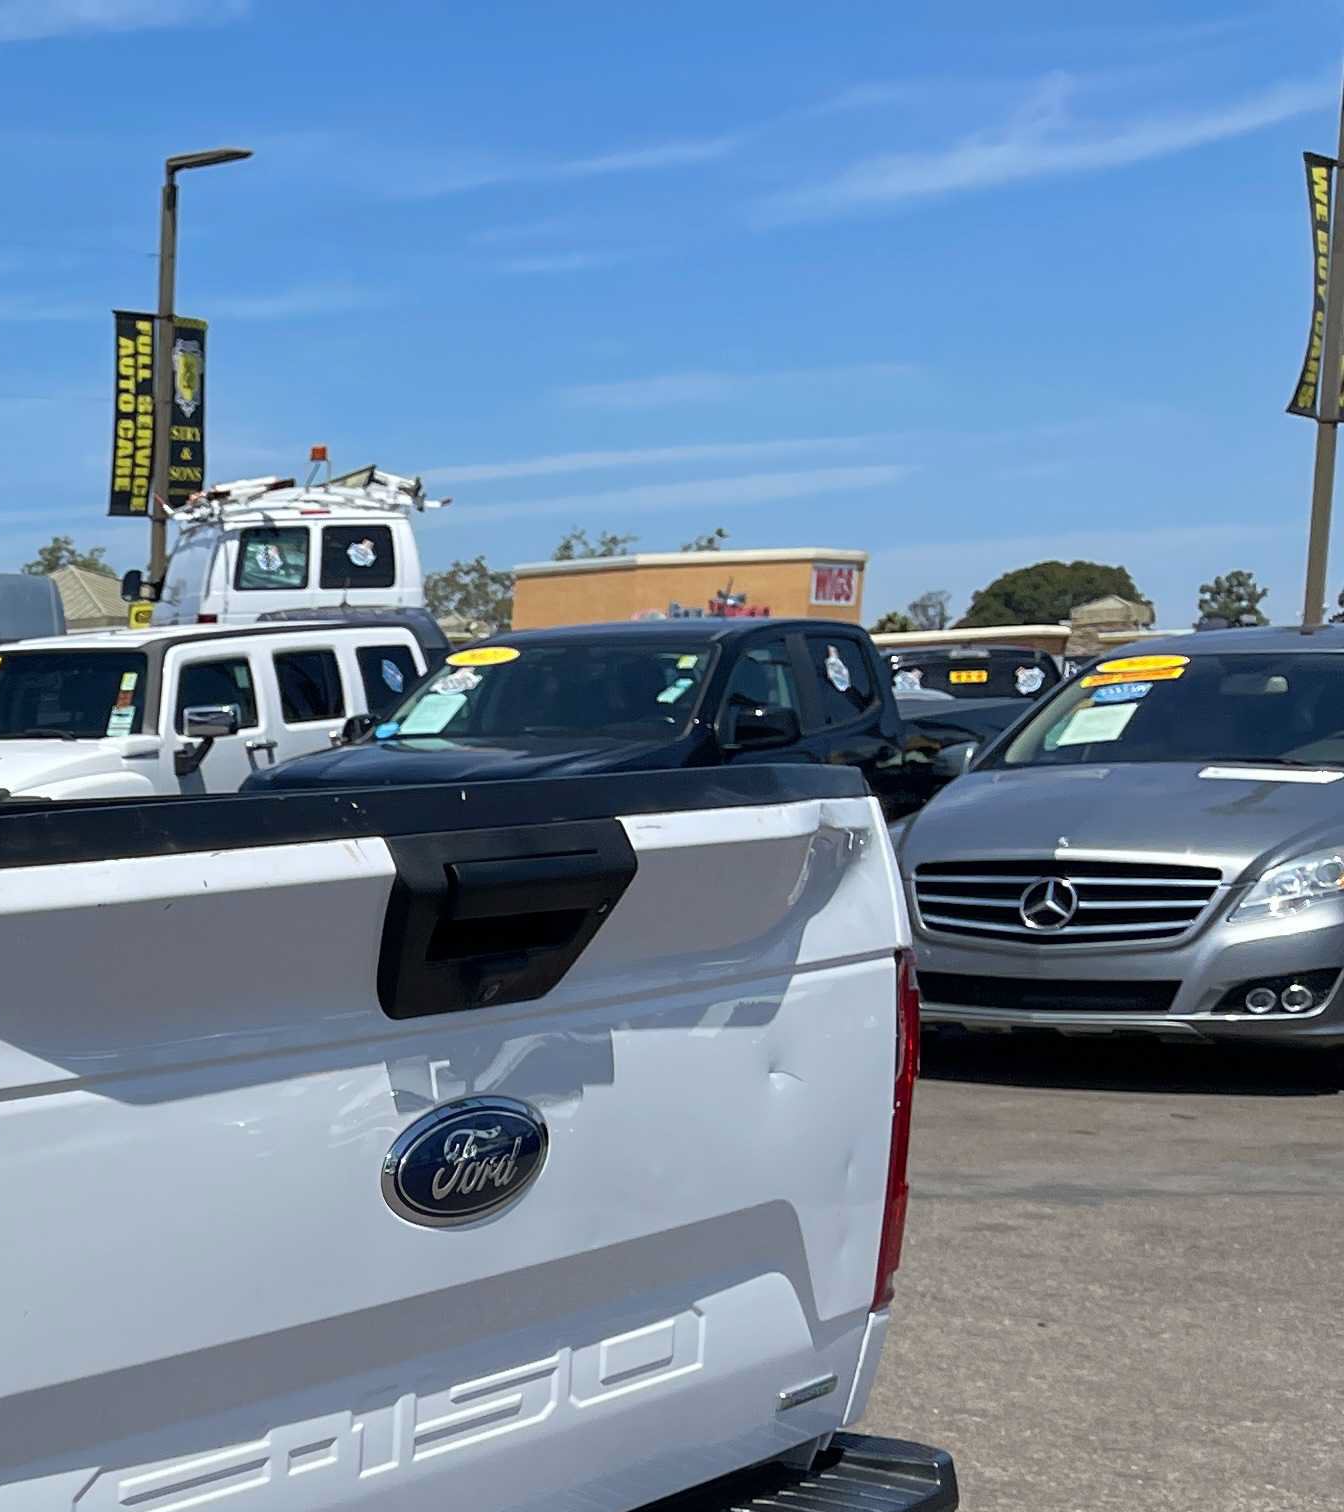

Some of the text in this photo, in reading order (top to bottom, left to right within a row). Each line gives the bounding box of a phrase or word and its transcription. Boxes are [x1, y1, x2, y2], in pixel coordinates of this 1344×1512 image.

[1311, 166, 1329, 222] WE
[113, 336, 136, 492] AUTO CARE
[129, 319, 154, 513] FULL SERVICE
[167, 466, 203, 482] SONS
[179, 446, 193, 462] &
[431, 1123, 523, 1200] Ford
